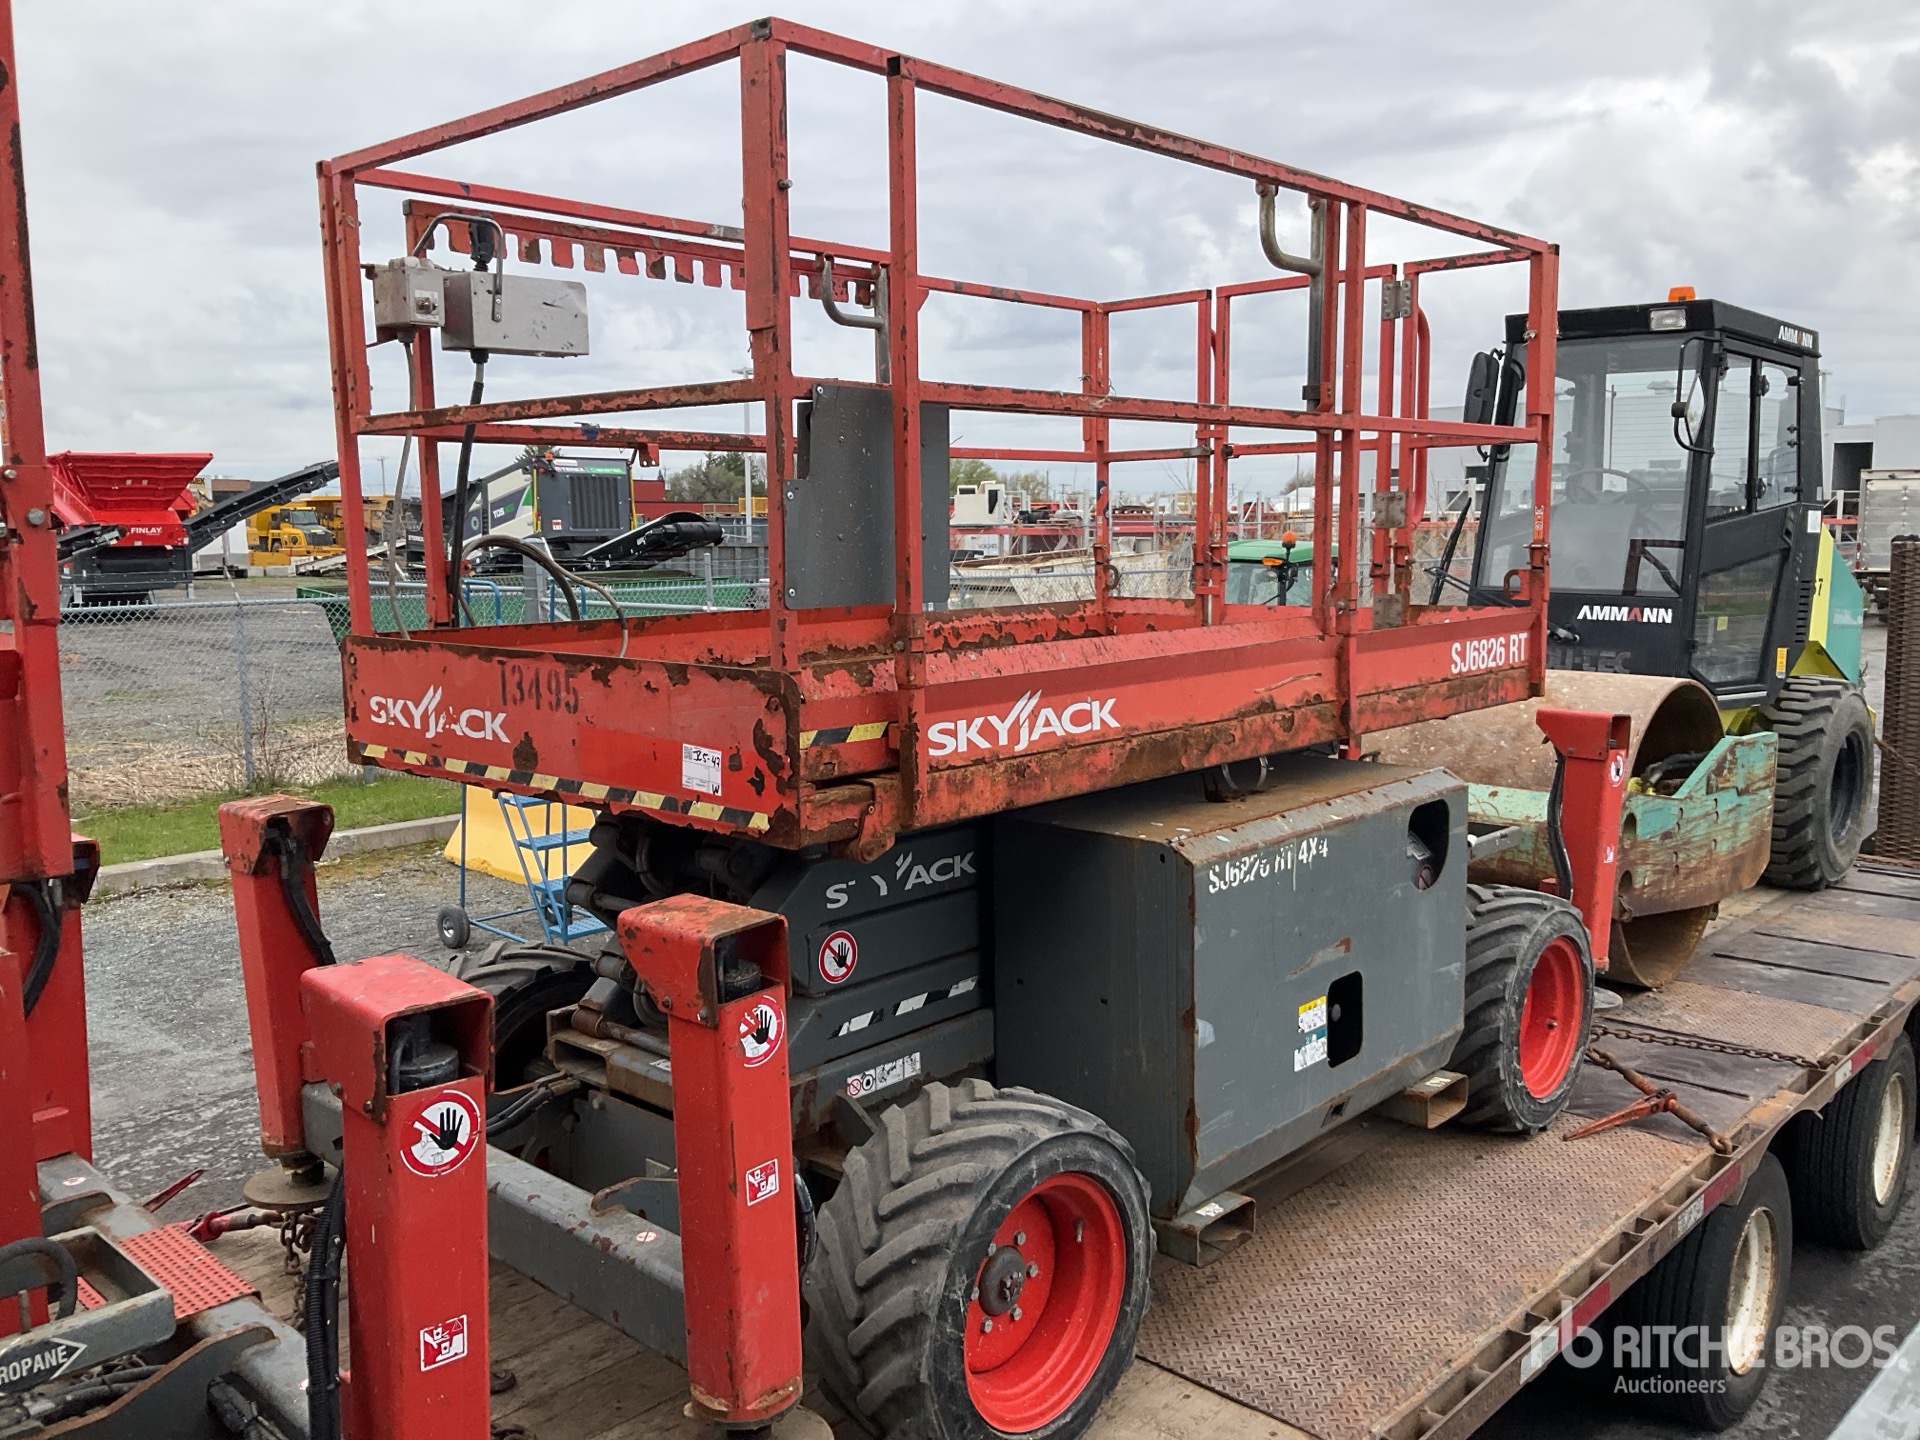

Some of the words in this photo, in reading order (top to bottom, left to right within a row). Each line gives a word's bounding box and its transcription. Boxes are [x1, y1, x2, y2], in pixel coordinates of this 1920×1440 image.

[1778, 325, 1813, 349] AMMANN
[130, 526, 162, 535] FINLAY
[1576, 604, 1673, 624] AMMANN
[1450, 636, 1506, 675] SJ6826
[1508, 632, 1528, 664] RT
[369, 684, 511, 744] SKYJACK
[926, 688, 1121, 757] SKYJACK
